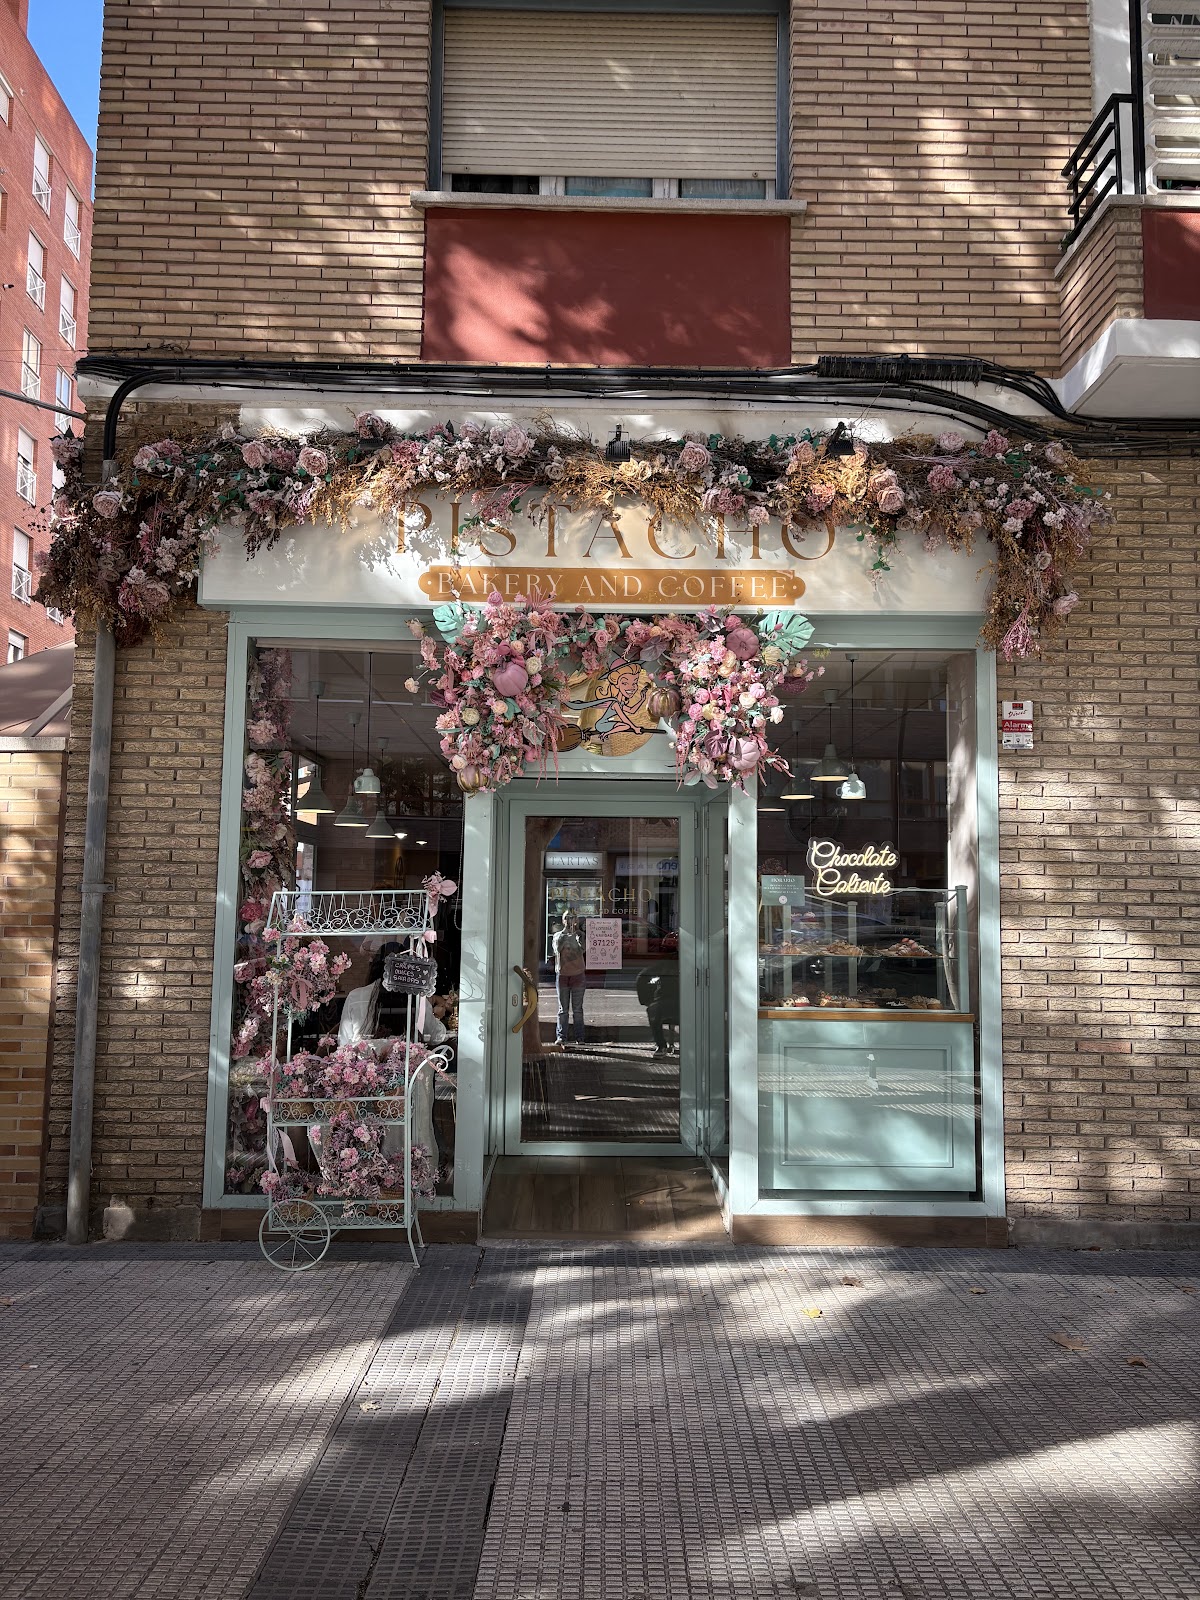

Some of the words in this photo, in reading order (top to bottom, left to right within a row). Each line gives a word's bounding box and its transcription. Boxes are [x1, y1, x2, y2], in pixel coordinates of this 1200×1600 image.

[395, 501, 836, 561] PISTACHO
[438, 571, 564, 597] BAKERY
[576, 574, 642, 597] AND
[658, 575, 788, 599] COFFEE
[549, 856, 599, 866] TARTAS
[810, 840, 897, 869] Chocolate
[549, 887, 652, 903] PISTACHO
[816, 868, 891, 896] Caliente
